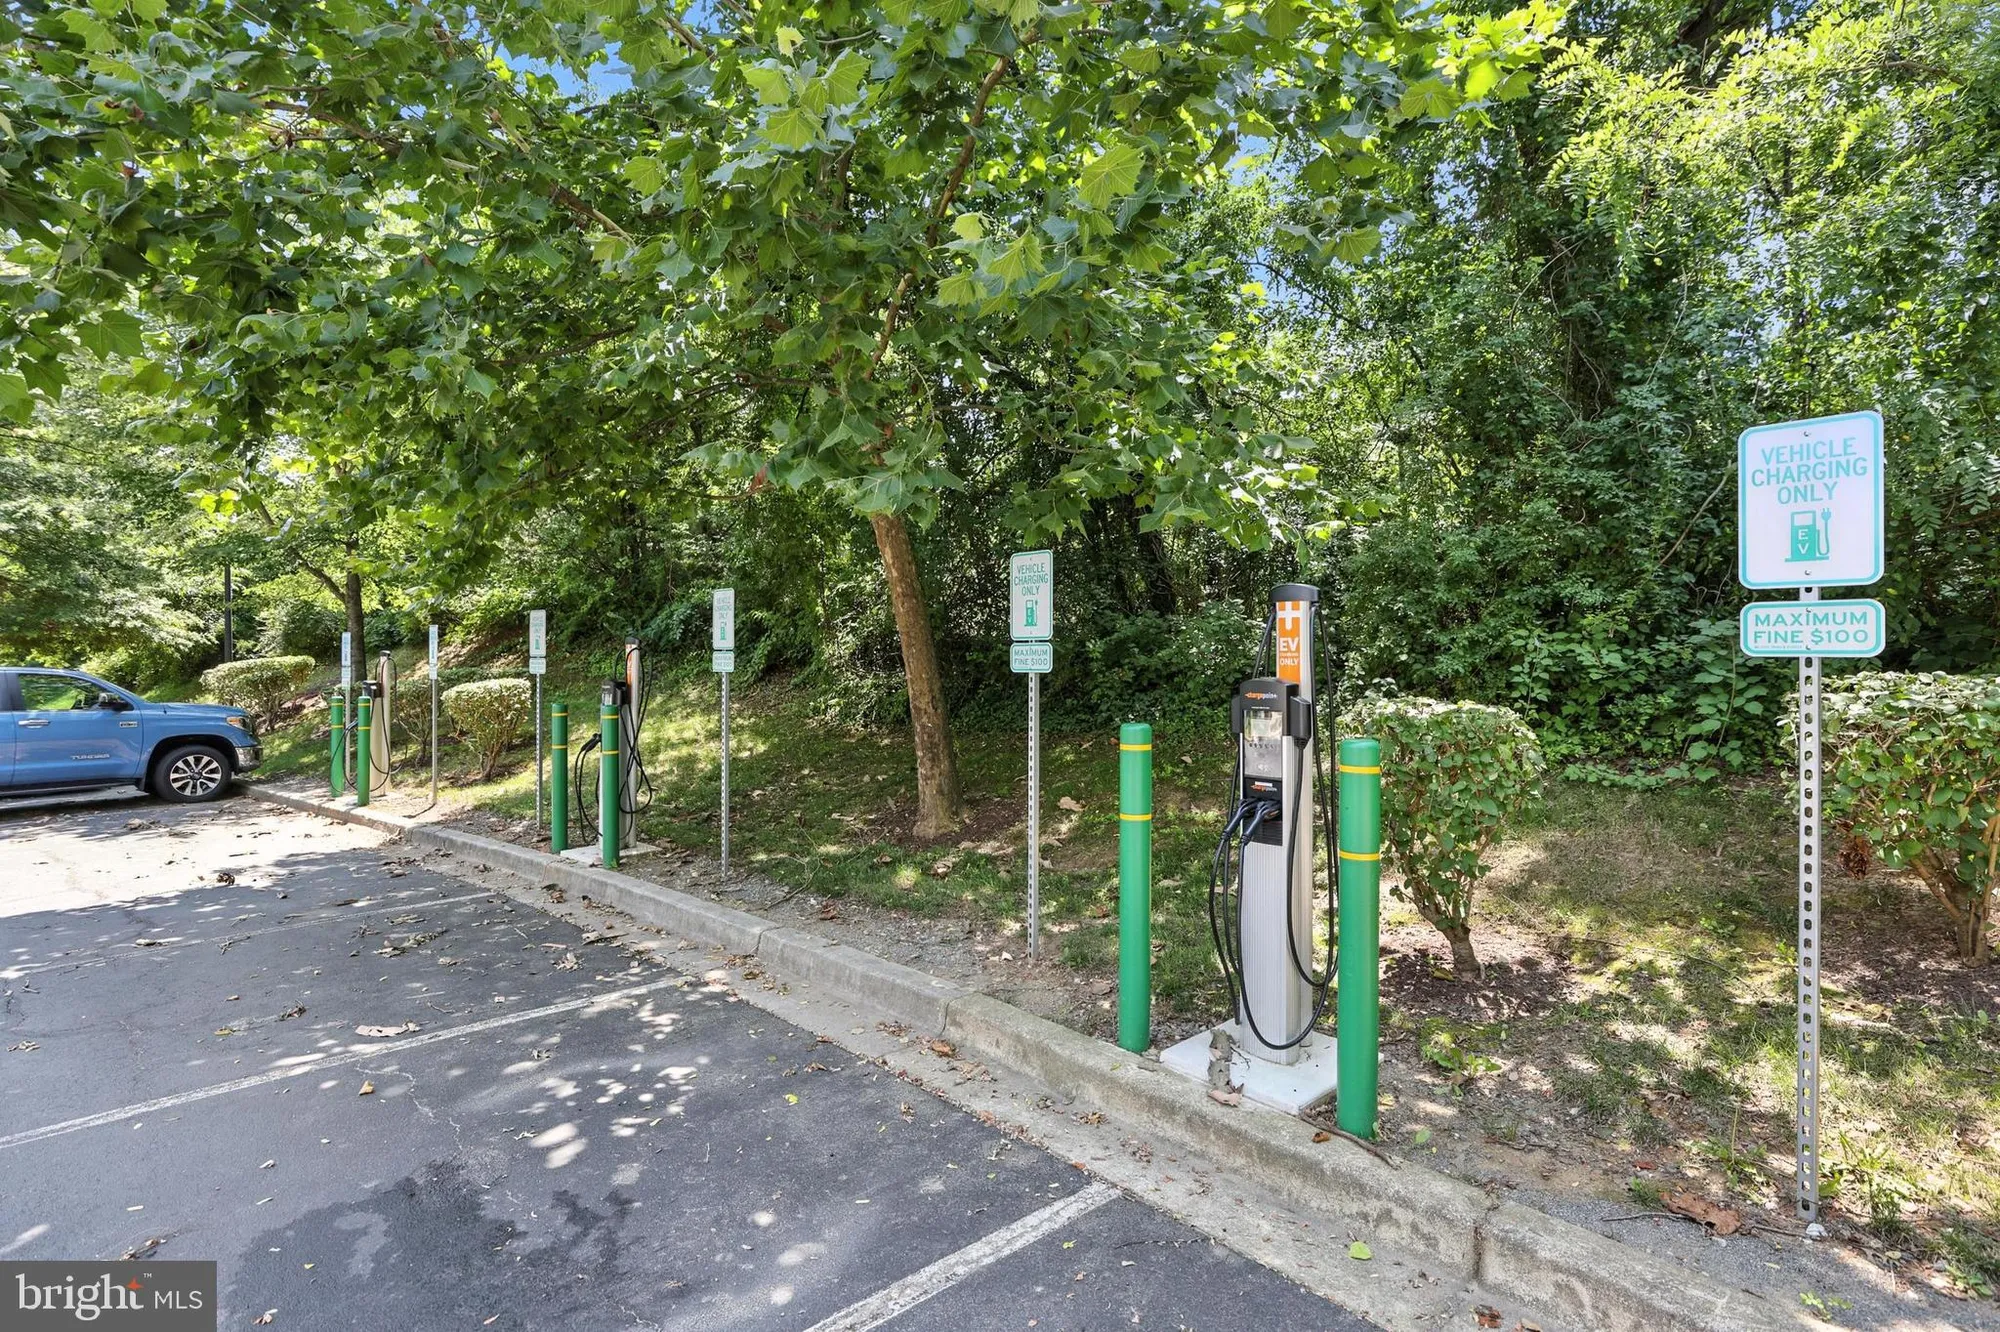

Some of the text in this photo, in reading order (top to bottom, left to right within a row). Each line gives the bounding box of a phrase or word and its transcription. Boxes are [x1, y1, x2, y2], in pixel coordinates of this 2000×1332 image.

[1761, 437, 1857, 465] VEHICLE
[1751, 457, 1868, 487] CHARGING
[1777, 481, 1838, 505] ONLY
[1016, 562, 1046, 575] VEHICLE
[1014, 573, 1049, 586] CHARGING
[1021, 585, 1040, 596] ONLY
[1754, 611, 1868, 627] MAXIMUM
[1754, 628, 1868, 645] FINE $100
[1279, 637, 1299, 651] EV
[1014, 648, 1048, 657] MAXIMUM
[1014, 658, 1030, 666] FINE
[1279, 657, 1300, 666] ONLY
